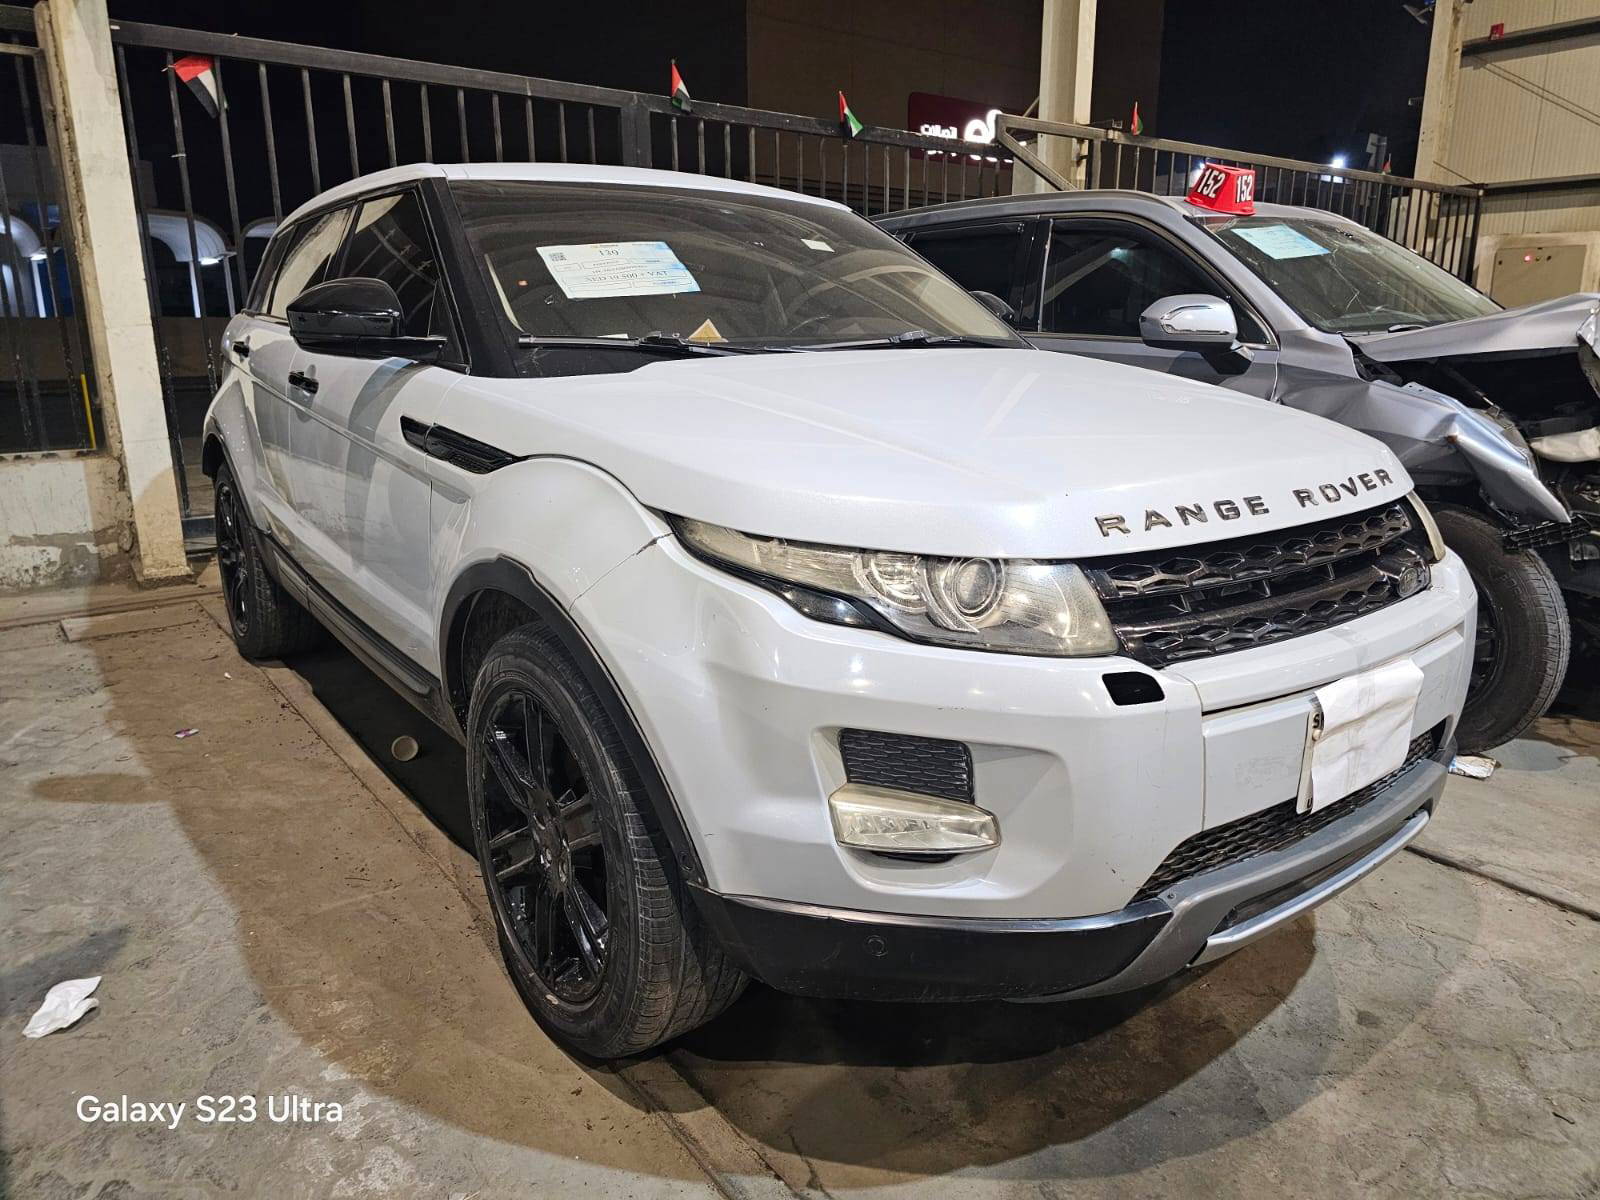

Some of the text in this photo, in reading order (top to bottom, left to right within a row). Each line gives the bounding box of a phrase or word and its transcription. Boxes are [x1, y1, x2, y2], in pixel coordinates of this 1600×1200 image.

[1197, 168, 1226, 199] 152
[1236, 174, 1253, 203] 152
[1094, 468, 1394, 537] RANGE ROVER
